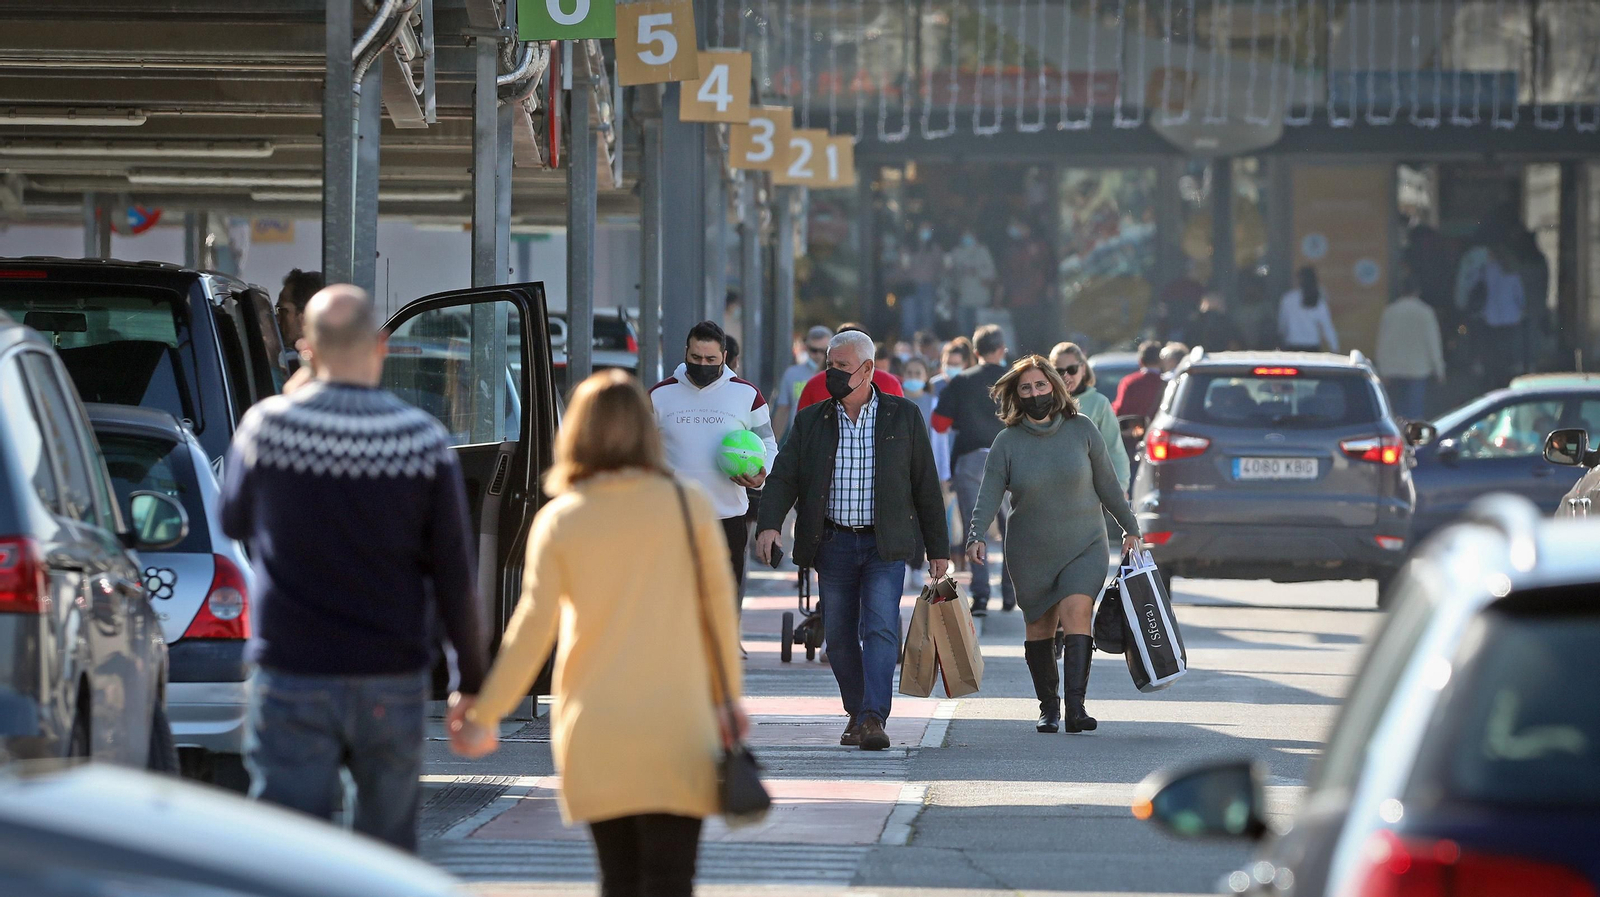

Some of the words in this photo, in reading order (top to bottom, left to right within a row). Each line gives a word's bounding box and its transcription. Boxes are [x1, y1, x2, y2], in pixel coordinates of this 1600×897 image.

[636, 12, 678, 66] 5
[696, 64, 734, 112] 4
[745, 117, 776, 162] 3
[785, 137, 815, 178] 2
[825, 143, 839, 181] 1
[676, 416, 691, 424] LIFE
[693, 416, 701, 424] IS
[1243, 459, 1279, 473] 4080
[1284, 459, 1313, 473] KBG
